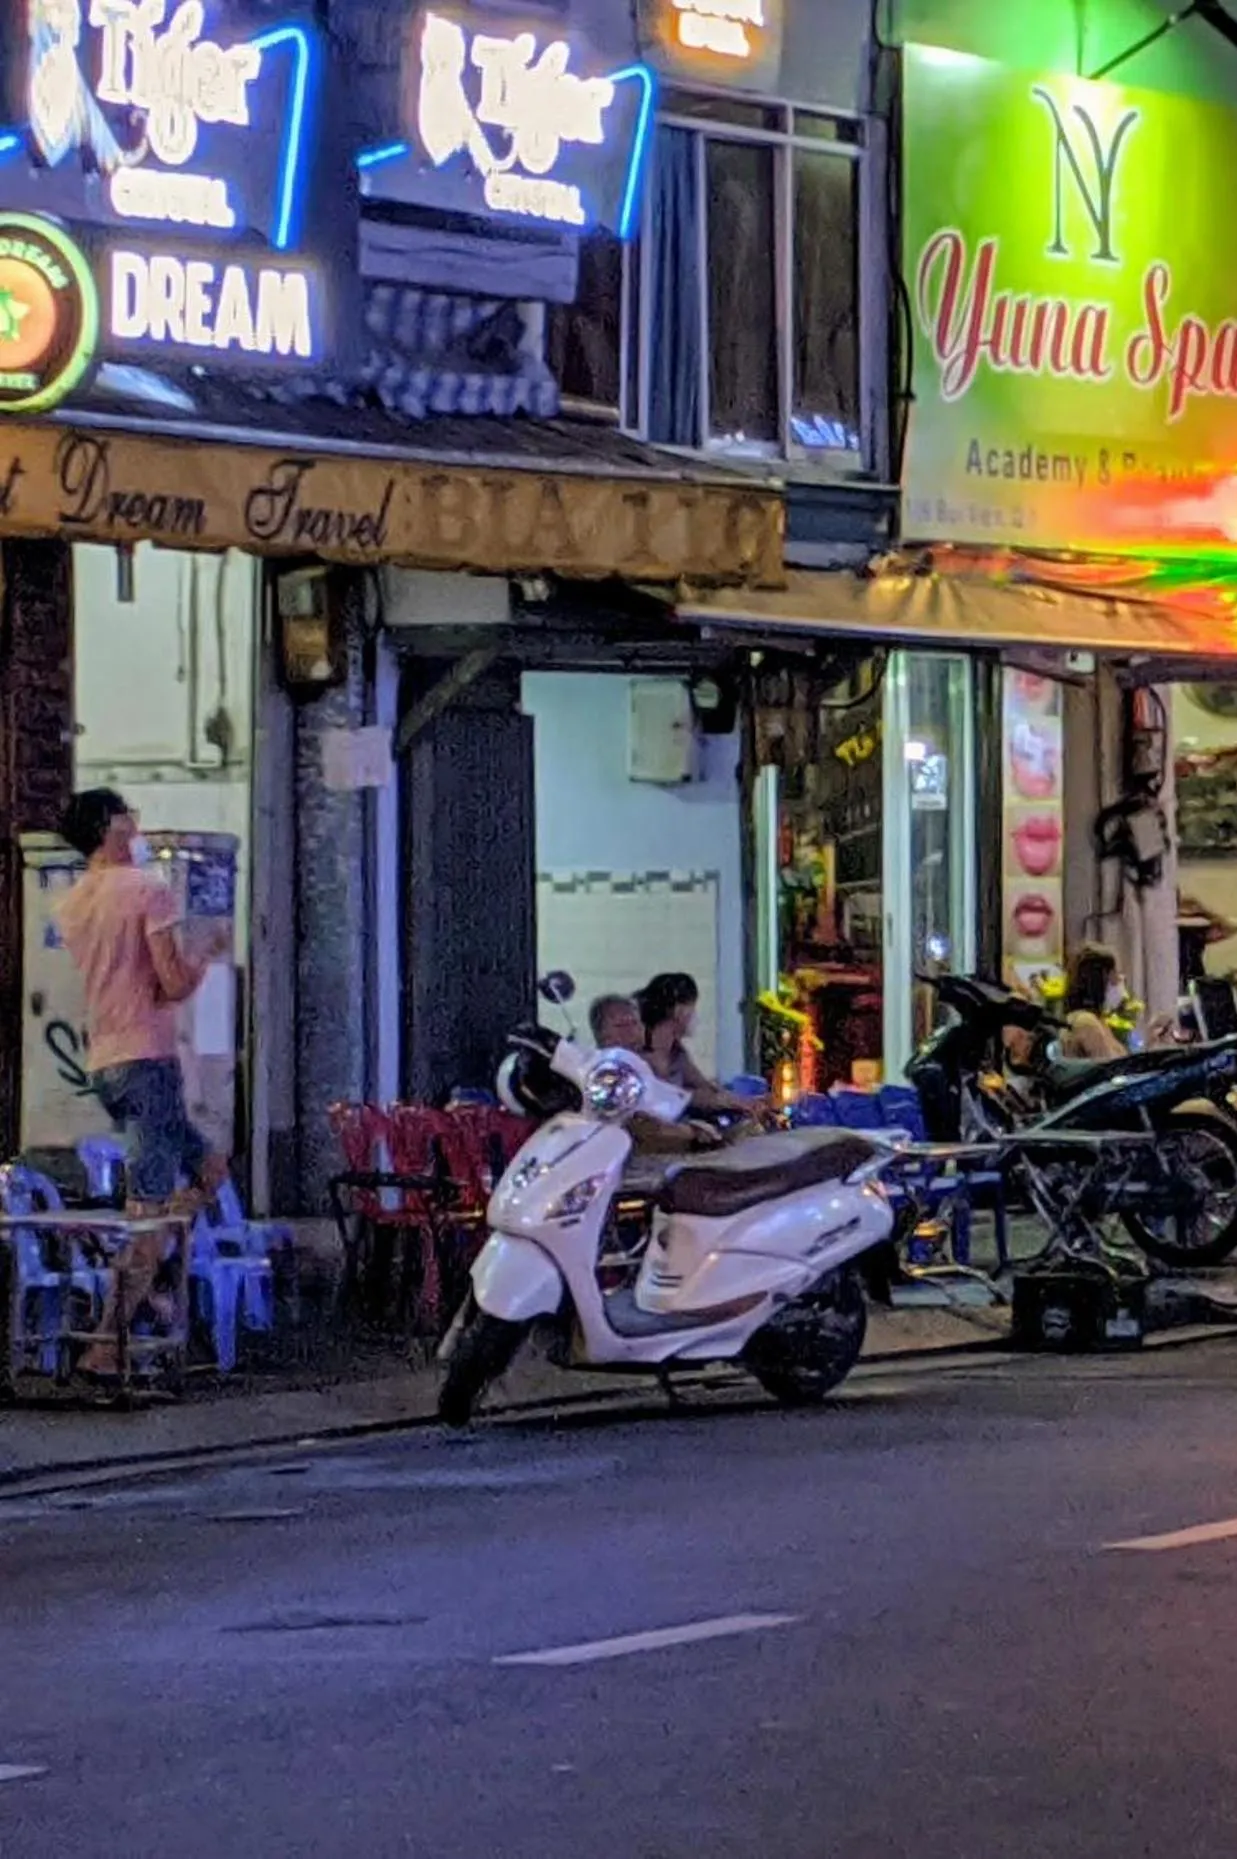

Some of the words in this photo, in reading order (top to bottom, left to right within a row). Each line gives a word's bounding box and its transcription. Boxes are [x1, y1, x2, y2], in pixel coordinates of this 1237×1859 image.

[111, 251, 311, 357] DREAM
[917, 231, 1112, 398] Yuna
[58, 430, 208, 535] Dream
[245, 460, 395, 549] Travel
[966, 438, 1088, 488] Academy
